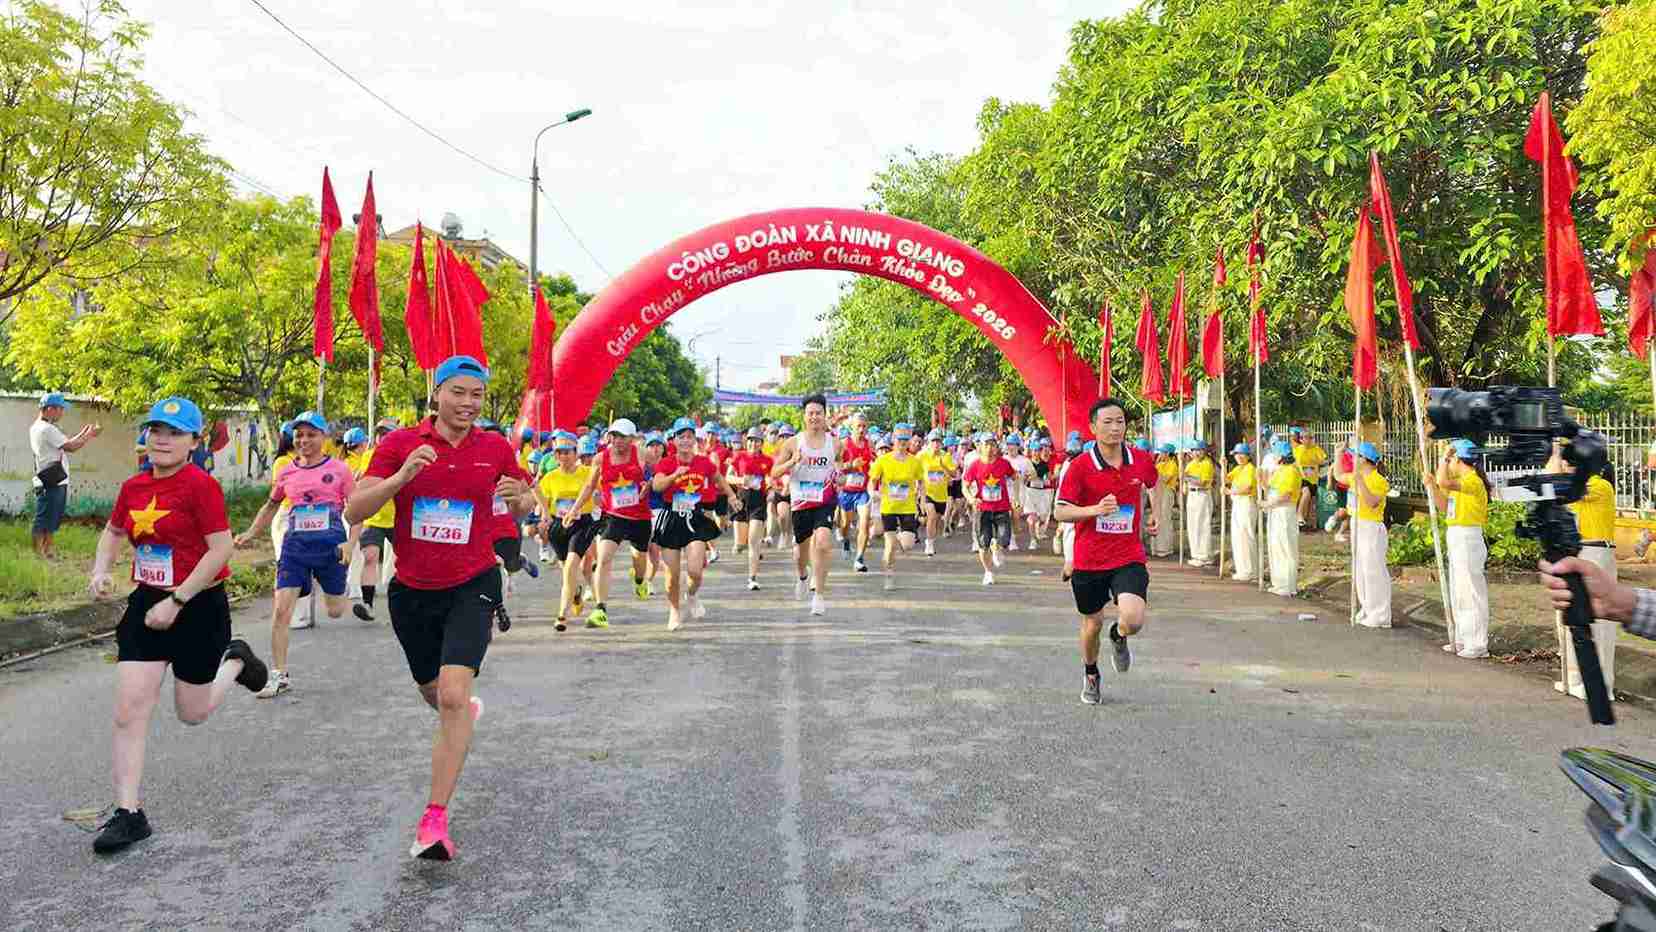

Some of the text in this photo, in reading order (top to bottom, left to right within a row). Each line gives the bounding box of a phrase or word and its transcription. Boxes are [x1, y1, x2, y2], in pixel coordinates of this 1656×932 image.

[667, 220, 965, 281] CÔNG ĐOÀN XÃ NINH GIANG
[822, 246, 873, 266] Chân
[971, 302, 1017, 341] 2026
[420, 525, 466, 540] 1736
